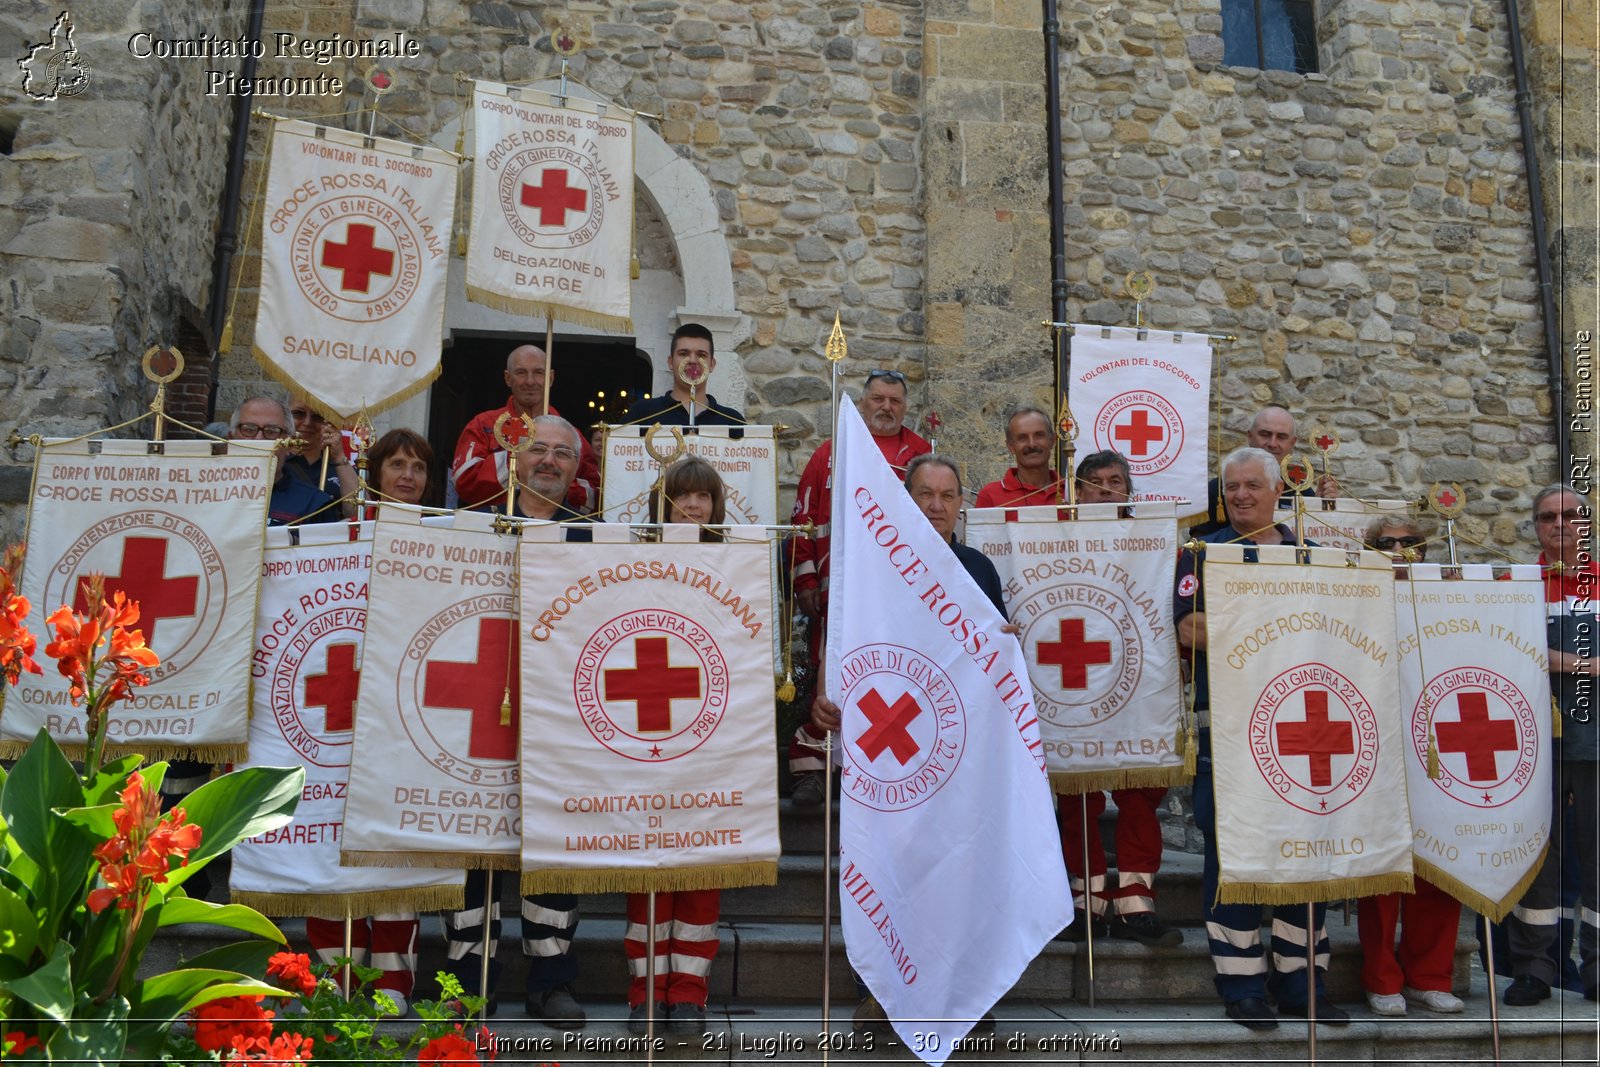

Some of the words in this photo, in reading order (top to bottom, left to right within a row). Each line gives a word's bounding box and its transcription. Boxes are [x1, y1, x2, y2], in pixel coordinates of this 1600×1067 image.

[481, 99, 512, 115] CORPO
[514, 108, 563, 125] VOLONTARI
[567, 117, 583, 129] DEL
[302, 142, 356, 163] VOLONTARI
[362, 156, 380, 168] DEL
[385, 159, 432, 178] SOCCORSO
[486, 133, 521, 171] CROCE
[523, 129, 576, 146] ROSSA
[516, 155, 527, 166] DI
[528, 149, 581, 166] GINEVRA
[584, 164, 597, 178] 22
[320, 205, 335, 219] DI
[501, 164, 535, 243] CONVENZIONE
[591, 184, 602, 231] AGOSTO
[270, 180, 319, 234] CROCE
[320, 173, 388, 192] ROSSA
[392, 185, 444, 260] ITALIANA
[340, 200, 400, 230] GINEVRA
[398, 234, 413, 250] 22
[568, 228, 592, 245] 1864
[295, 218, 338, 311] CONVENZIONE
[493, 247, 590, 273] DELEGAZIONE
[594, 266, 605, 279] DI
[397, 253, 416, 300] AGOSTO
[515, 272, 583, 293] BARGE
[367, 300, 397, 318] 1864
[282, 336, 416, 367] SAVIGLIANO
[1080, 358, 1129, 383] VOLONTARI
[1153, 360, 1200, 390] SOCCORSO
[1099, 395, 1144, 432] CONVENZIONE
[1157, 401, 1179, 435] GINEVRA
[702, 446, 719, 456] DEL
[725, 447, 769, 458] SOCCORSO
[1154, 454, 1170, 470] 1864
[94, 466, 160, 481] VOLONTARI
[168, 468, 192, 483] DEL
[198, 466, 259, 483] SOCCORSO
[37, 485, 102, 501] CROCE
[110, 487, 177, 503] ROSSA
[185, 486, 267, 504] ITALIANA
[57, 513, 155, 575] CONVENZIONE
[162, 516, 176, 530] DI
[183, 525, 220, 576] GINEVRA
[390, 539, 435, 559] CORPO
[1018, 540, 1079, 554] VOLONTARI
[1086, 540, 1107, 552] DEL
[1113, 538, 1165, 551] SOCCORSO
[295, 555, 360, 573] VOLONTARI
[376, 560, 453, 584] CROCE
[854, 487, 929, 586] CROCE
[919, 582, 1000, 675] ROSSA
[1225, 581, 1259, 595] CORPO
[1261, 581, 1317, 595] VOLONTARI
[1318, 583, 1331, 596] DEL
[1332, 583, 1380, 598] SOCCORSO
[530, 575, 599, 642] CROCE
[598, 561, 679, 587] ROSSA
[681, 566, 764, 640] ITALIANA
[1022, 558, 1096, 582] ROSSA
[1103, 563, 1165, 641] ITALIANA
[1028, 602, 1042, 616] DI
[1047, 588, 1117, 614] GINEVRA
[1446, 594, 1468, 604] DEL
[1474, 593, 1535, 604] SOCCORSO
[251, 609, 298, 678] CROCE
[300, 582, 369, 614] ROSSA
[408, 598, 513, 661] CONVENZIONE
[604, 624, 620, 641] DI
[621, 614, 685, 634] GINEVRA
[1118, 614, 1132, 633] 22
[1423, 619, 1481, 641] ROSSA
[293, 638, 312, 652] DI
[688, 628, 706, 644] 22
[1226, 622, 1279, 670] CROCE
[1278, 611, 1328, 634] ROSSA
[1330, 618, 1389, 668] ITALIANA
[887, 650, 903, 671] DI
[1120, 638, 1138, 691] AGOSTO
[701, 645, 725, 707] AGOSTO
[1275, 679, 1290, 694] DI
[1290, 668, 1338, 688] GINEVRA
[1444, 672, 1499, 693] GINEVRA
[578, 637, 615, 741] CONVENZIONE
[907, 658, 958, 731] GINEVRA
[1340, 684, 1355, 700] 22
[1431, 682, 1444, 697] DI
[1504, 684, 1519, 701] 22
[124, 694, 199, 710] LOCALE
[205, 691, 220, 706] DI
[276, 657, 320, 759] CONVENZIONE
[1090, 693, 1123, 717] 1864
[46, 715, 194, 736] RACONIGI
[692, 710, 718, 740] 1864
[1351, 701, 1375, 768] AGOSTO
[1515, 700, 1535, 757] AGOSTO
[937, 739, 957, 759] 22
[1084, 741, 1104, 758] DI
[1113, 737, 1170, 757] ALBA
[1252, 690, 1291, 794] CONVENZIONE
[886, 757, 946, 805] AGOSTO
[1347, 766, 1370, 791] 1864
[1514, 761, 1532, 786] 1864
[852, 774, 882, 803] 1864
[563, 794, 666, 812] COMITATO
[670, 791, 743, 810] LOCALE
[648, 816, 662, 827] DI
[1454, 824, 1507, 836] GRUPPO
[1513, 822, 1524, 834] DI
[565, 835, 640, 851] LIMONE
[644, 830, 742, 850] PIEMONTE
[1280, 838, 1364, 858] CENTALLO
[1415, 828, 1459, 861] PINO
[1477, 824, 1548, 867] TORINESE
[841, 860, 918, 985] MILLESIMO
